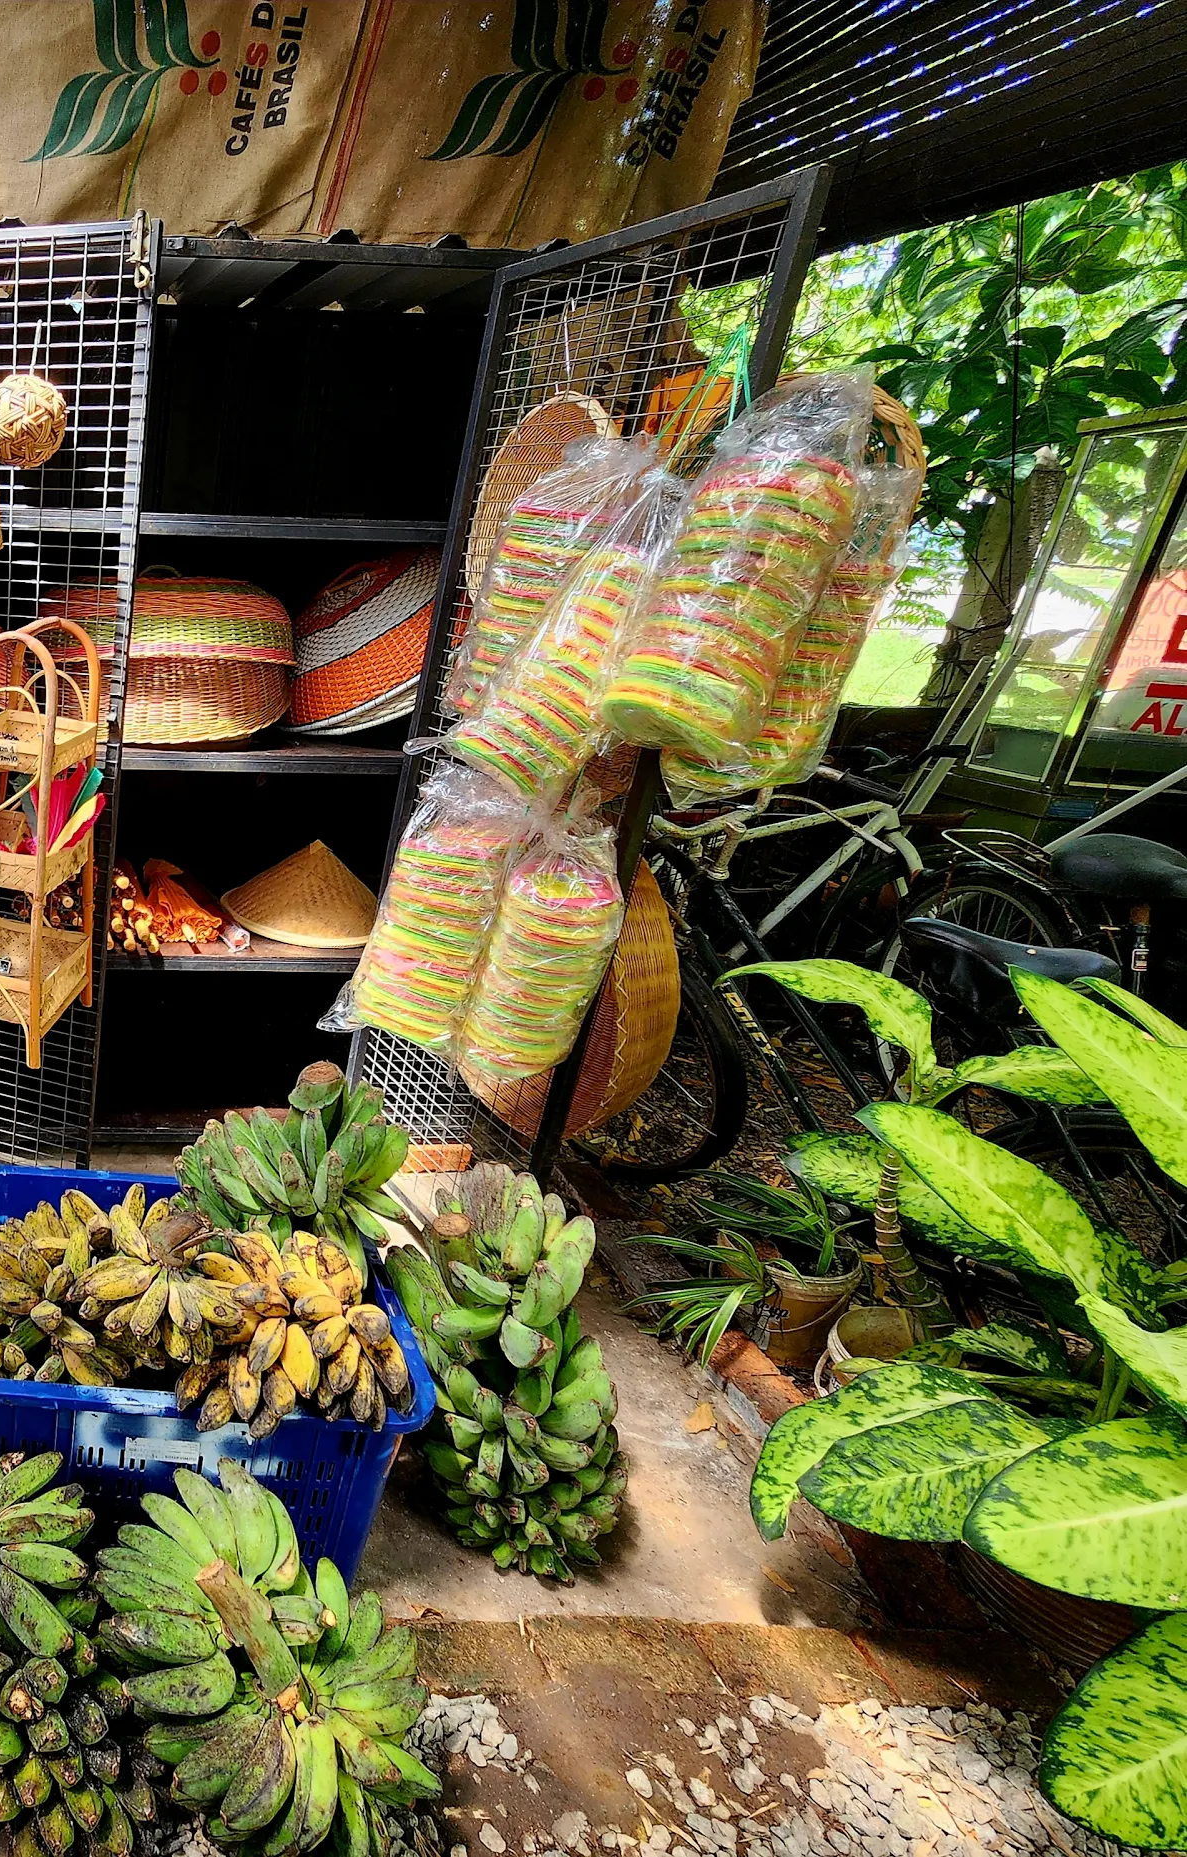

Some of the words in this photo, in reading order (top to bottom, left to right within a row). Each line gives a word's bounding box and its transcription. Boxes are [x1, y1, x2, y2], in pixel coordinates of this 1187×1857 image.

[225, 42, 269, 157] CAFÉS
[251, 0, 275, 30] D
[263, 6, 309, 130] BRASIL
[674, 0, 708, 37] D
[654, 28, 727, 160] BRASIL
[1129, 701, 1187, 737] AL
